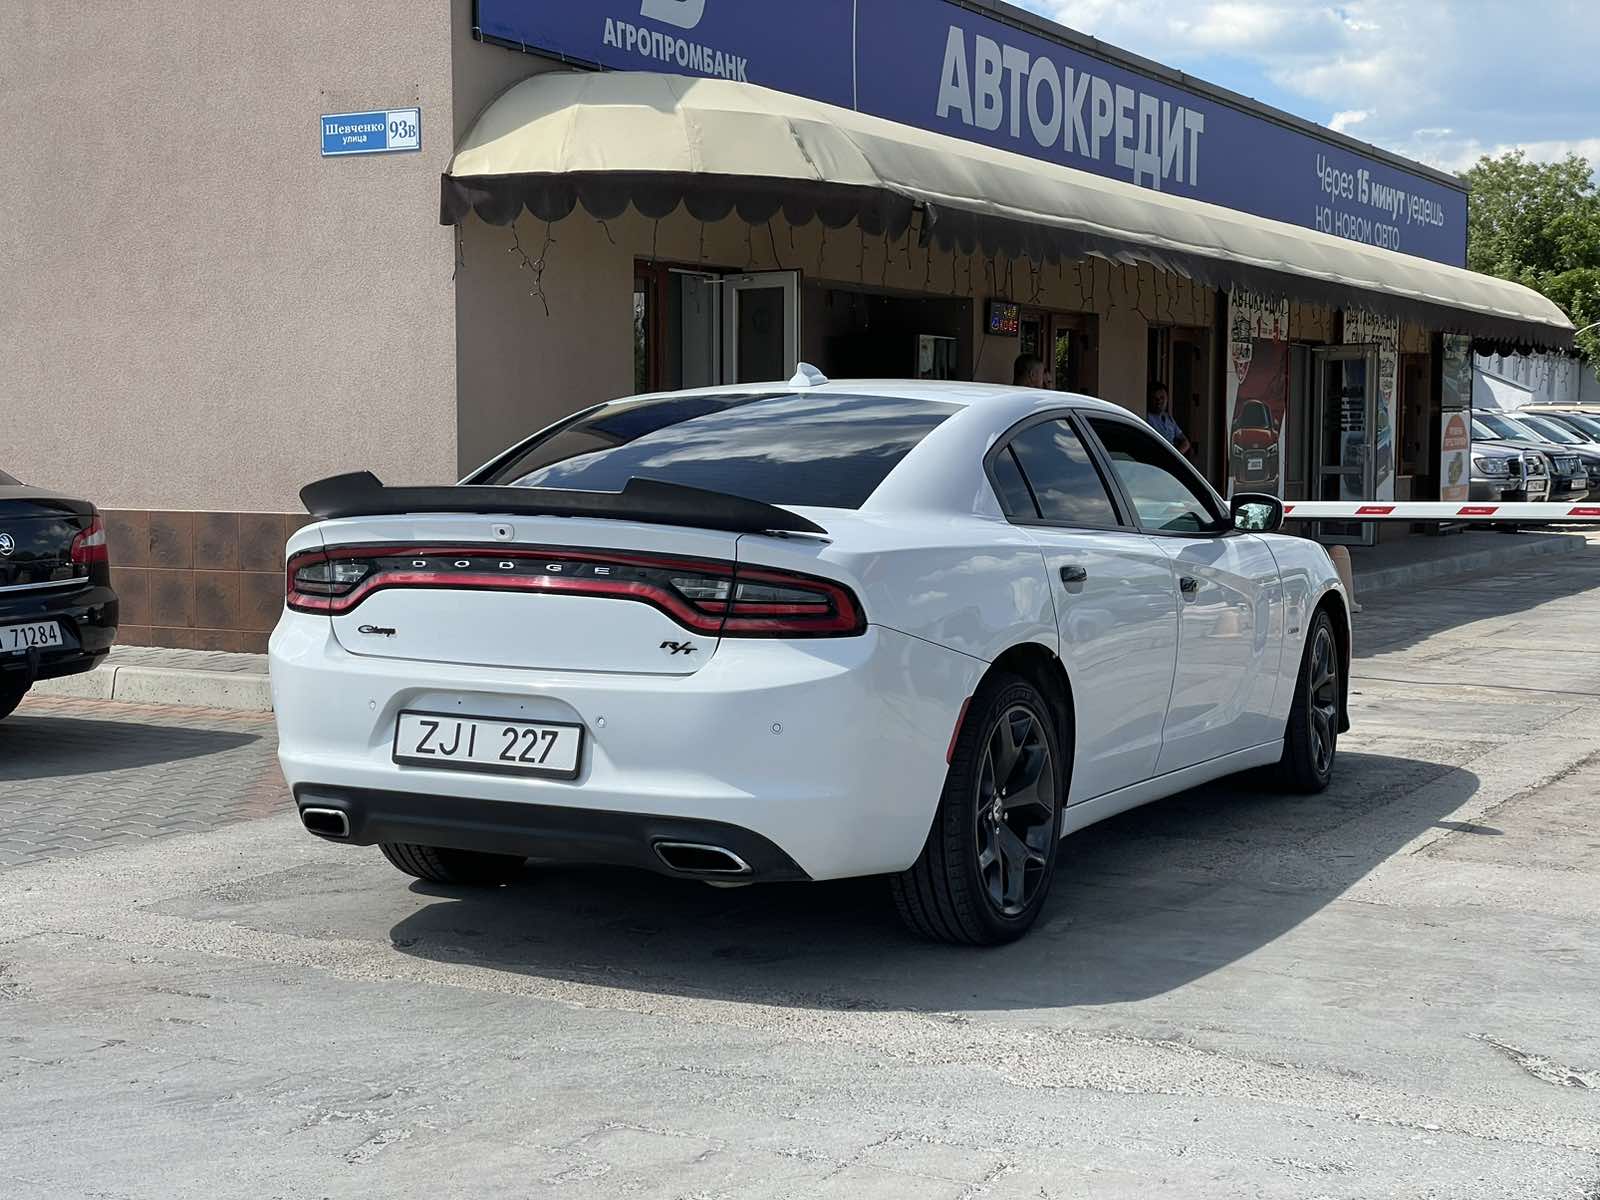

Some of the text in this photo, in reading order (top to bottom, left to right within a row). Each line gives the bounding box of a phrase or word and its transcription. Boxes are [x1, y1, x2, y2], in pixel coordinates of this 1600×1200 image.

[603, 18, 748, 82] АГРОПРОМБАНК
[936, 25, 1204, 190] АВТОКРЕДИТ
[325, 123, 385, 135] Шевченко
[342, 135, 368, 145] улица
[1316, 153, 1444, 227] Через 15 минут уедешь
[1315, 204, 1400, 250] на новом авто
[412, 559, 611, 575] DODGE
[10, 624, 57, 647] 71284
[659, 641, 698, 655] R/T
[415, 720, 559, 764] ZJI 227
